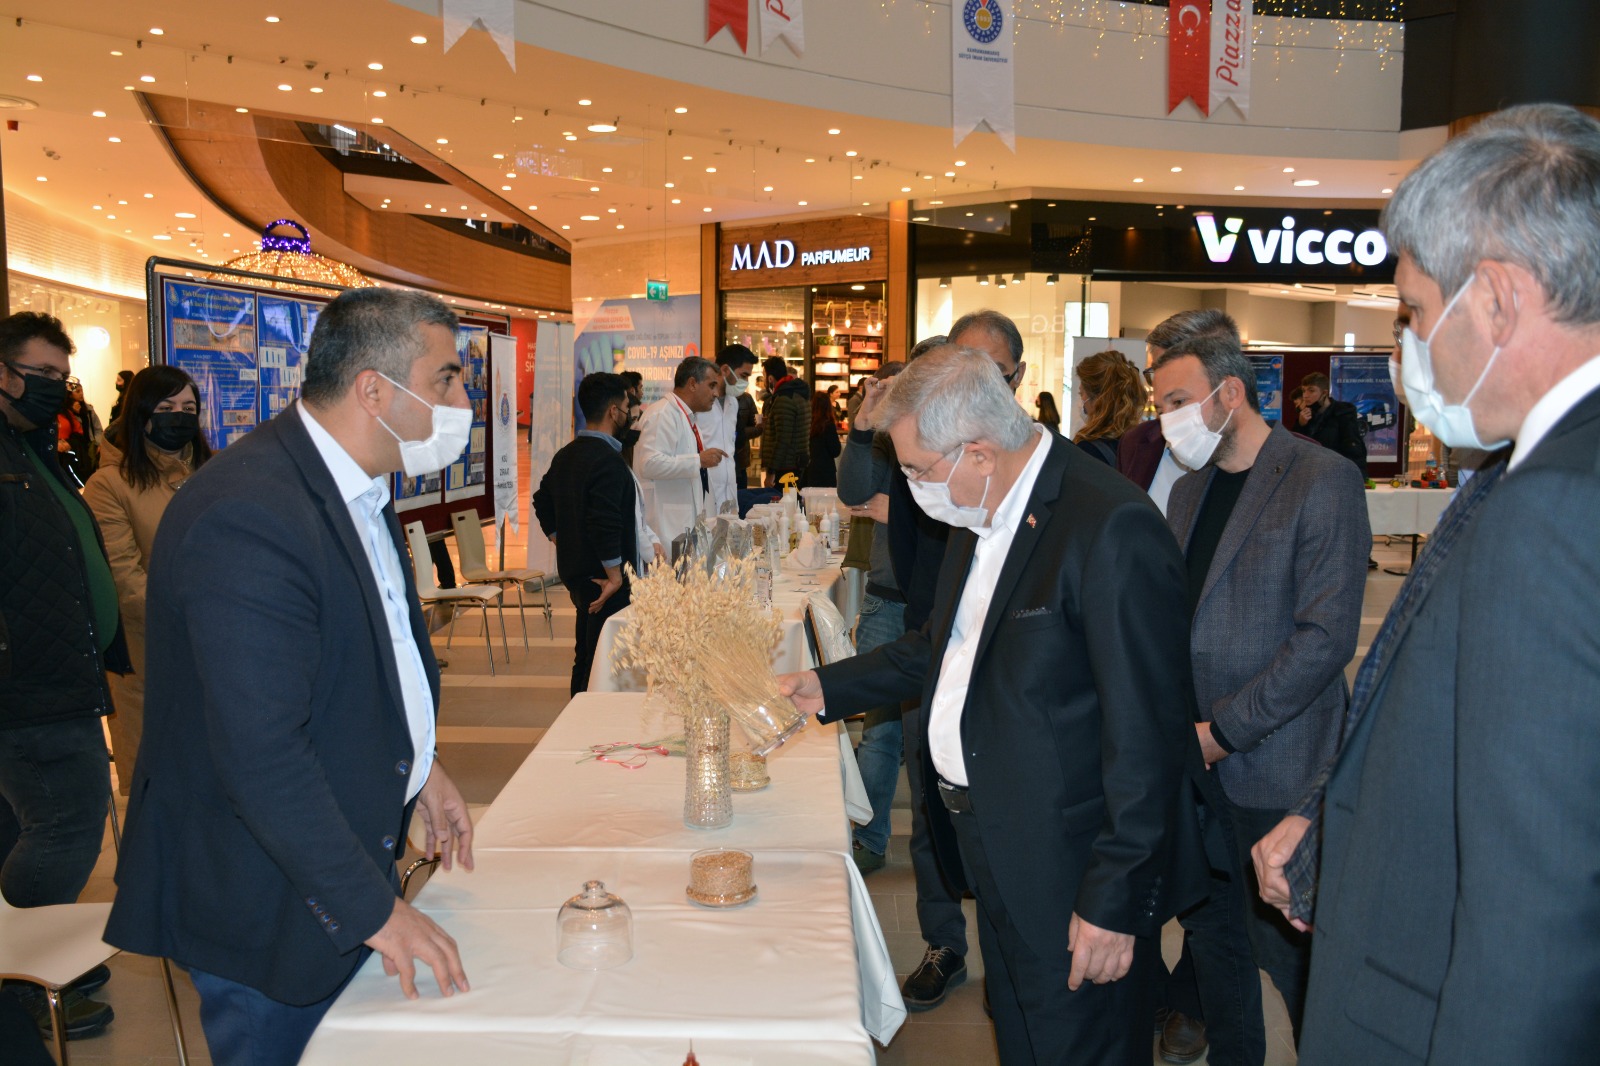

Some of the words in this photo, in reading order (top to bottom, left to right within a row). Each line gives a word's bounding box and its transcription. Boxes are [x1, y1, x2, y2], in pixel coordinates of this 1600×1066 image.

[1216, 0, 1242, 86] Piazza
[1247, 216, 1388, 266] vicco
[801, 246, 870, 267] PARFUMEUR
[627, 346, 658, 359] COVID-19
[628, 366, 672, 381] TIRDINIZ
